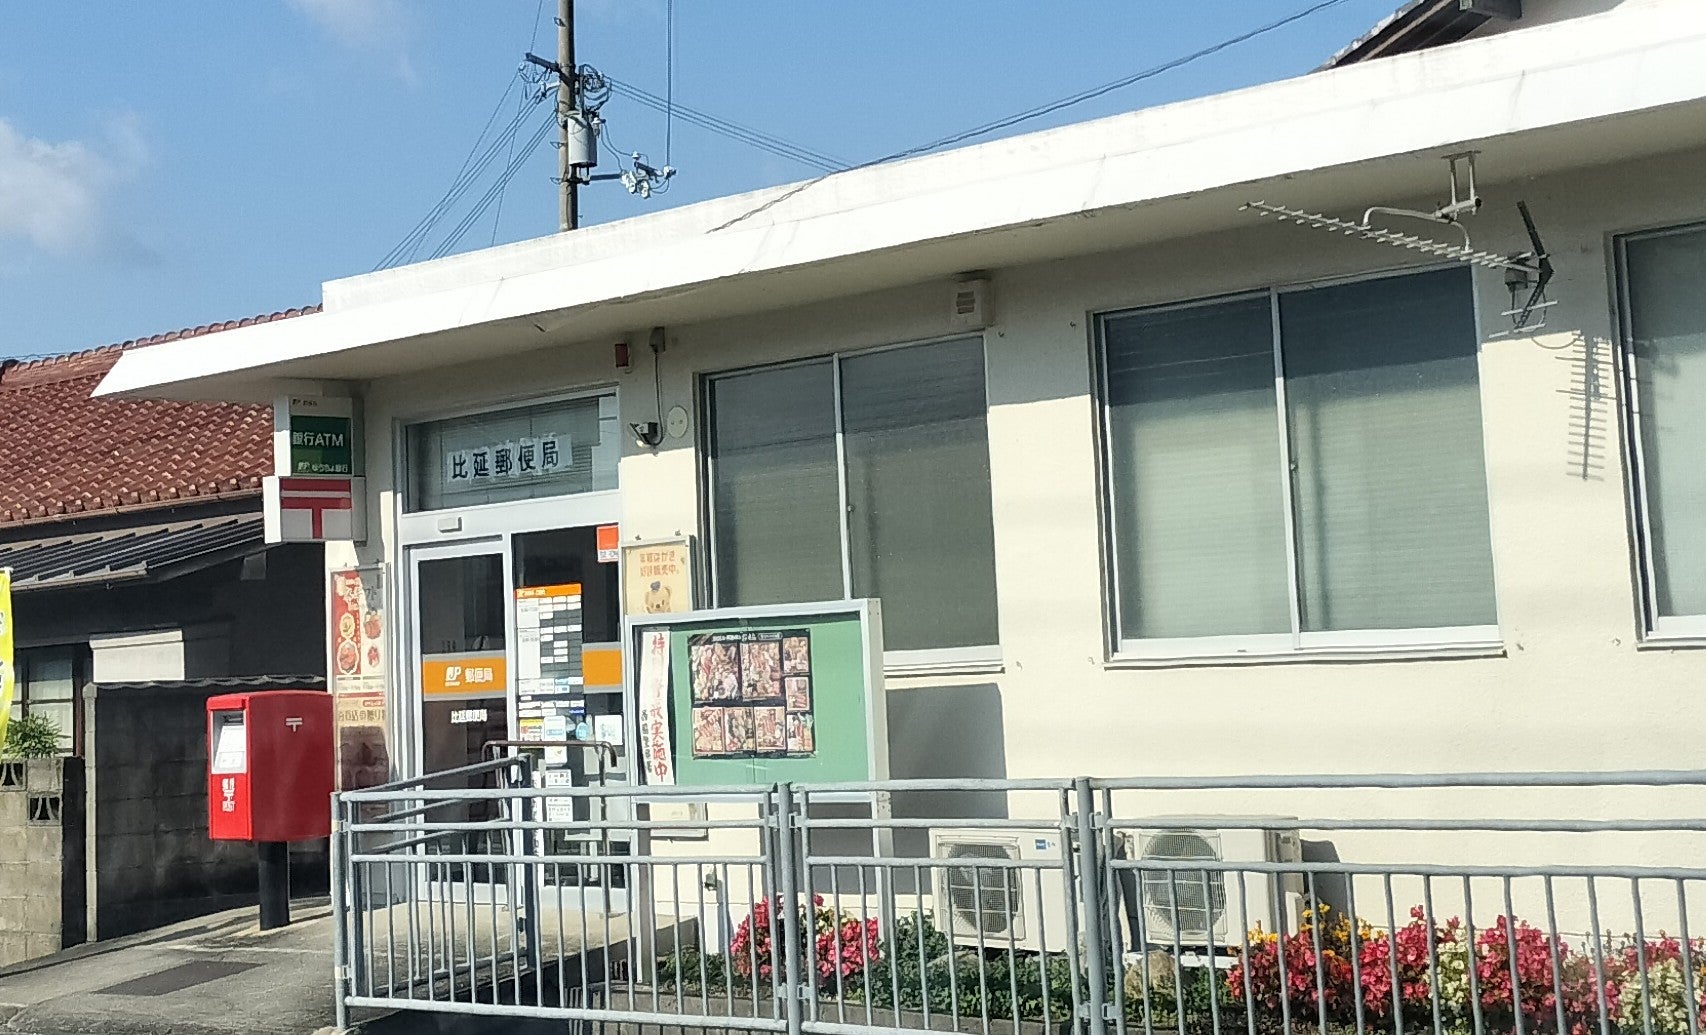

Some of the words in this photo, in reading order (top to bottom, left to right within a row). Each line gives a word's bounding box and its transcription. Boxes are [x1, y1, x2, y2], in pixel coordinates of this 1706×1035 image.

[293, 431, 344, 447] 銀行ATM
[452, 440, 559, 479] 比延郵便局
[465, 667, 493, 683] 郵便局
